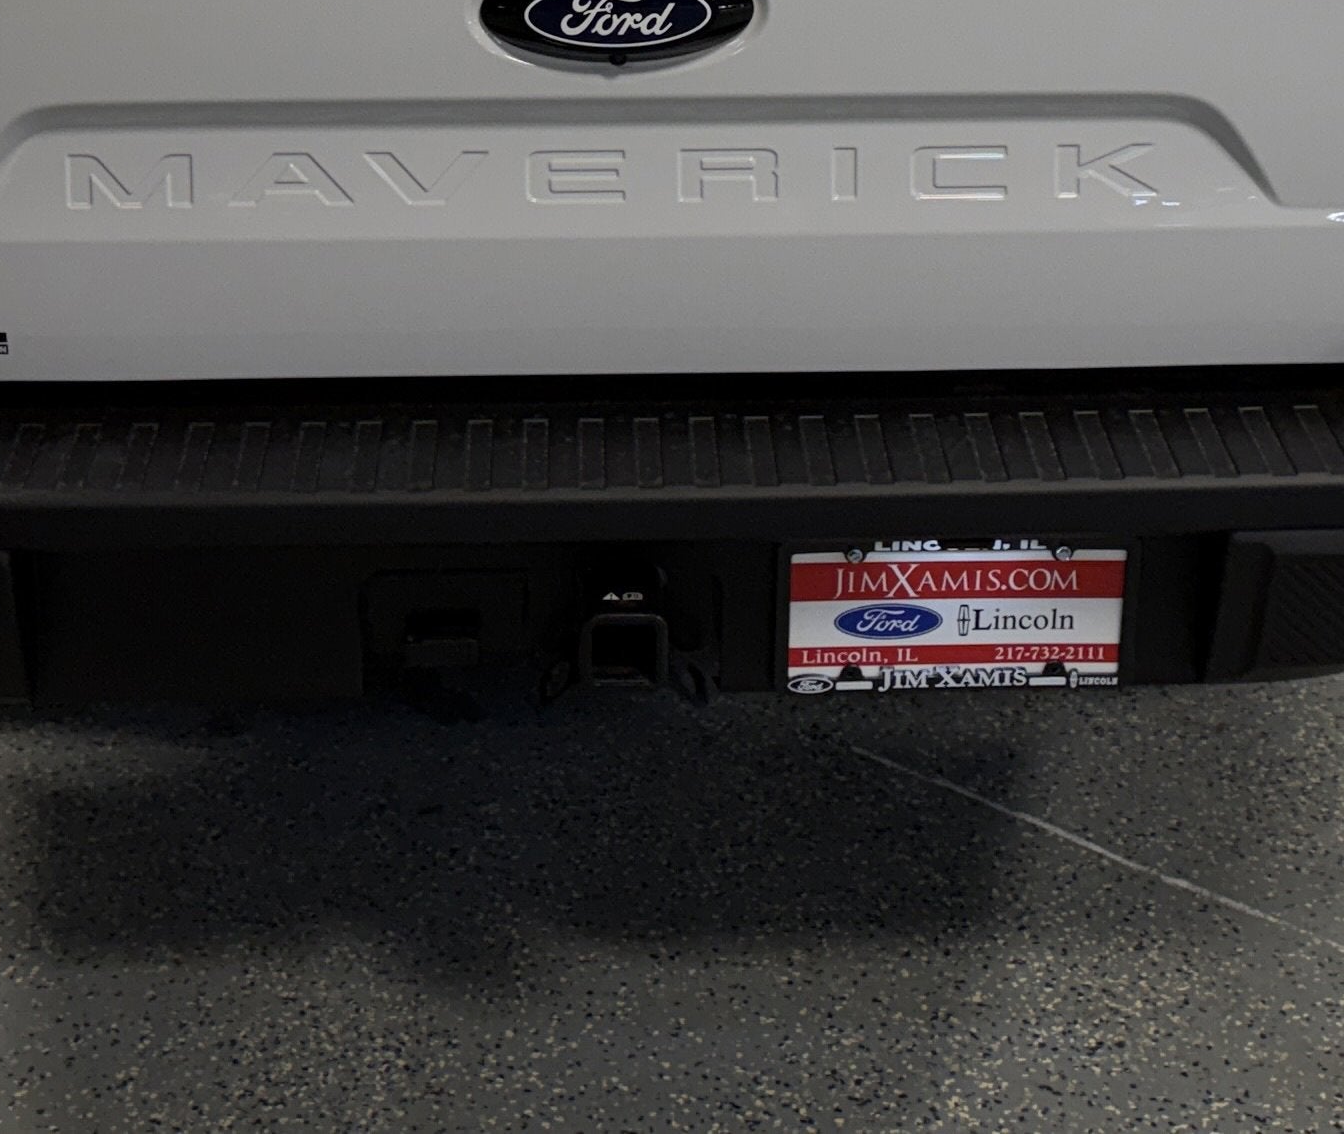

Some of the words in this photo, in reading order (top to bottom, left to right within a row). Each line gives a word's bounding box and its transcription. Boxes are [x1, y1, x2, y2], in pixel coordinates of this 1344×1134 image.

[64, 146, 1162, 210] MAVERICK
[1020, 539, 1047, 550] IL
[833, 563, 1080, 599] JIMXAMIS.COM
[856, 608, 920, 633] Ford
[972, 608, 1074, 630] Lincoln
[802, 648, 888, 665] Lincoln,
[896, 648, 919, 662] IL
[994, 646, 1105, 661] 217-732-2111
[877, 667, 929, 692] JIM
[934, 666, 1027, 688] XAMIS
[1078, 676, 1118, 685] LINCOLN
